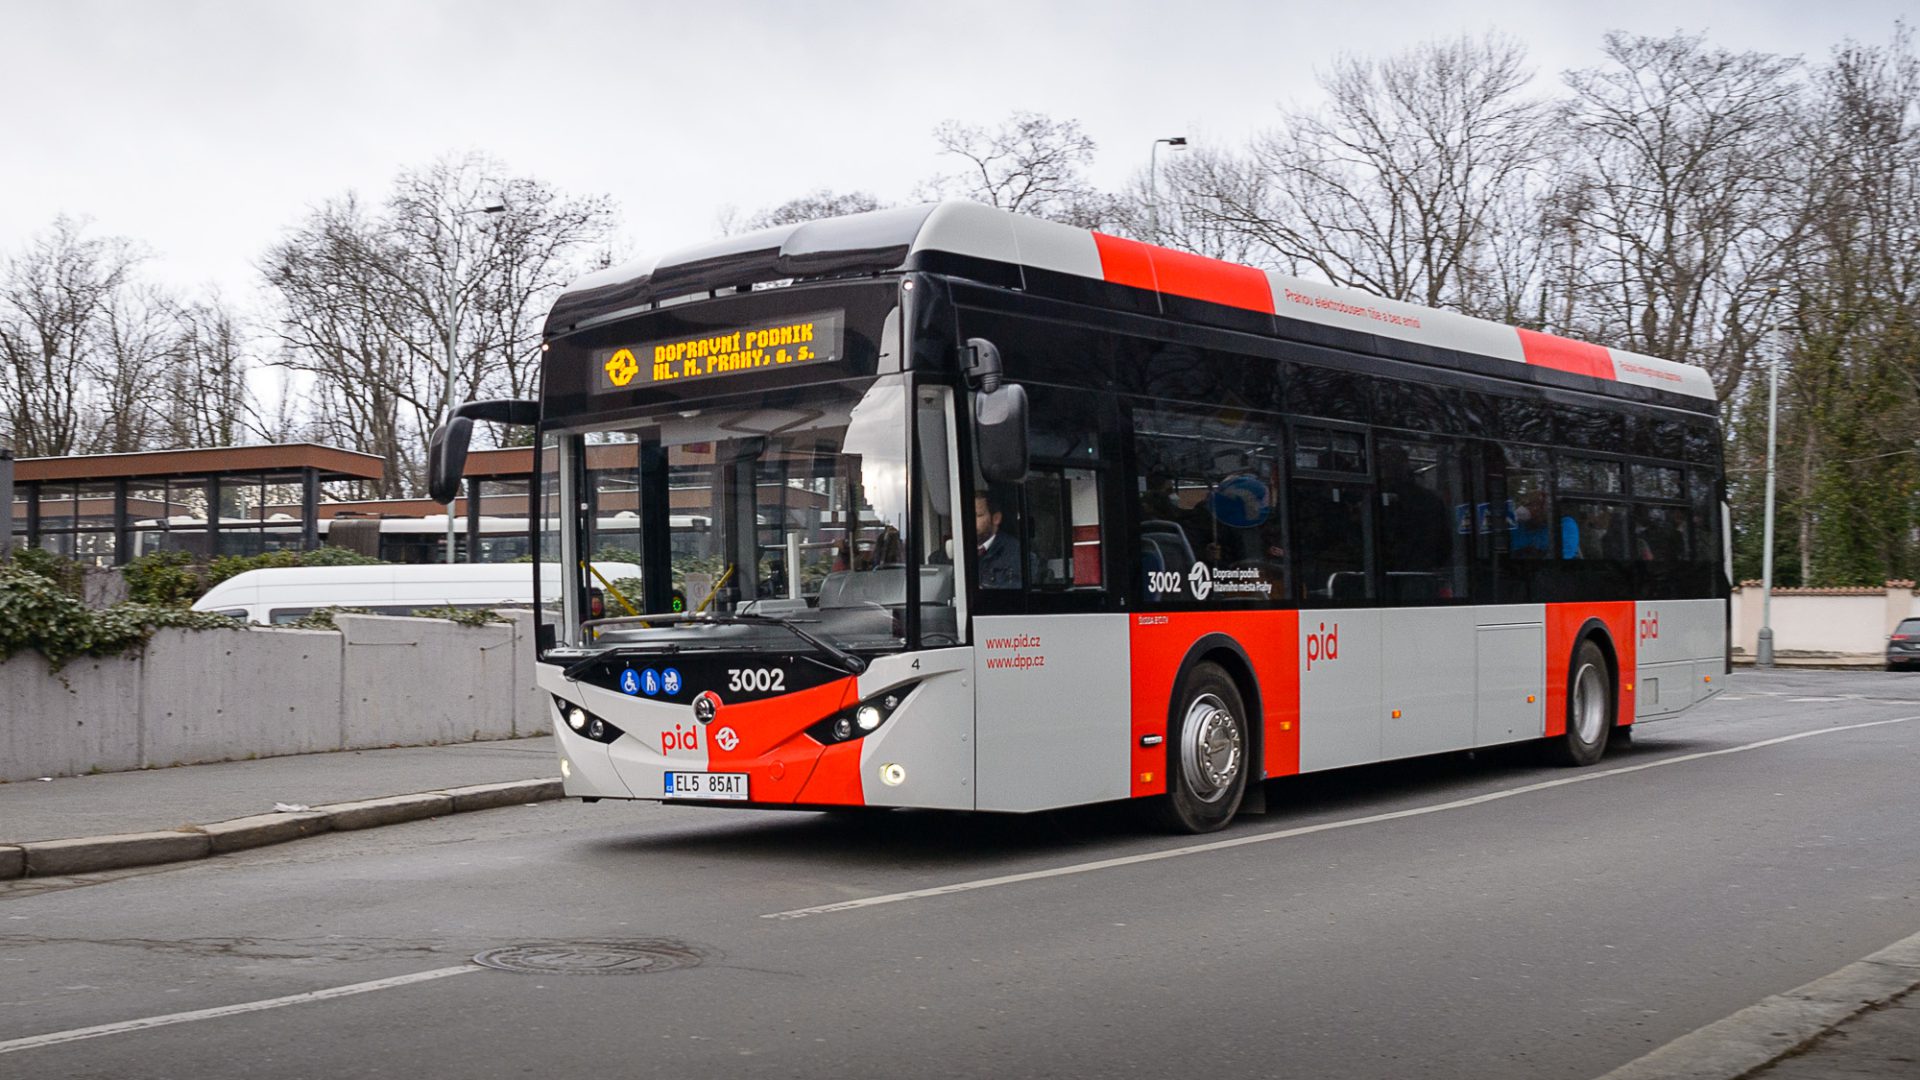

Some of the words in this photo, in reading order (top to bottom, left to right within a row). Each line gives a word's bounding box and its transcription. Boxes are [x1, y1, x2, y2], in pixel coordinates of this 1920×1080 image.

[654, 331, 740, 364] DOPRAVNÍ
[746, 323, 813, 349] PODNIK
[653, 363, 679, 381] HL.
[684, 359, 702, 377] M.
[707, 349, 770, 373] PRAHY,
[1148, 571, 1181, 593] 3002
[1640, 610, 1659, 648] pid
[985, 633, 1041, 652] www.pid.cz
[1307, 622, 1338, 671] pid
[911, 658, 921, 671] 4
[987, 654, 1045, 670] www.dpp.cz
[728, 668, 785, 692] 3002
[661, 723, 698, 756] pid
[676, 775, 699, 792] EL5
[709, 776, 741, 793] 85AT
